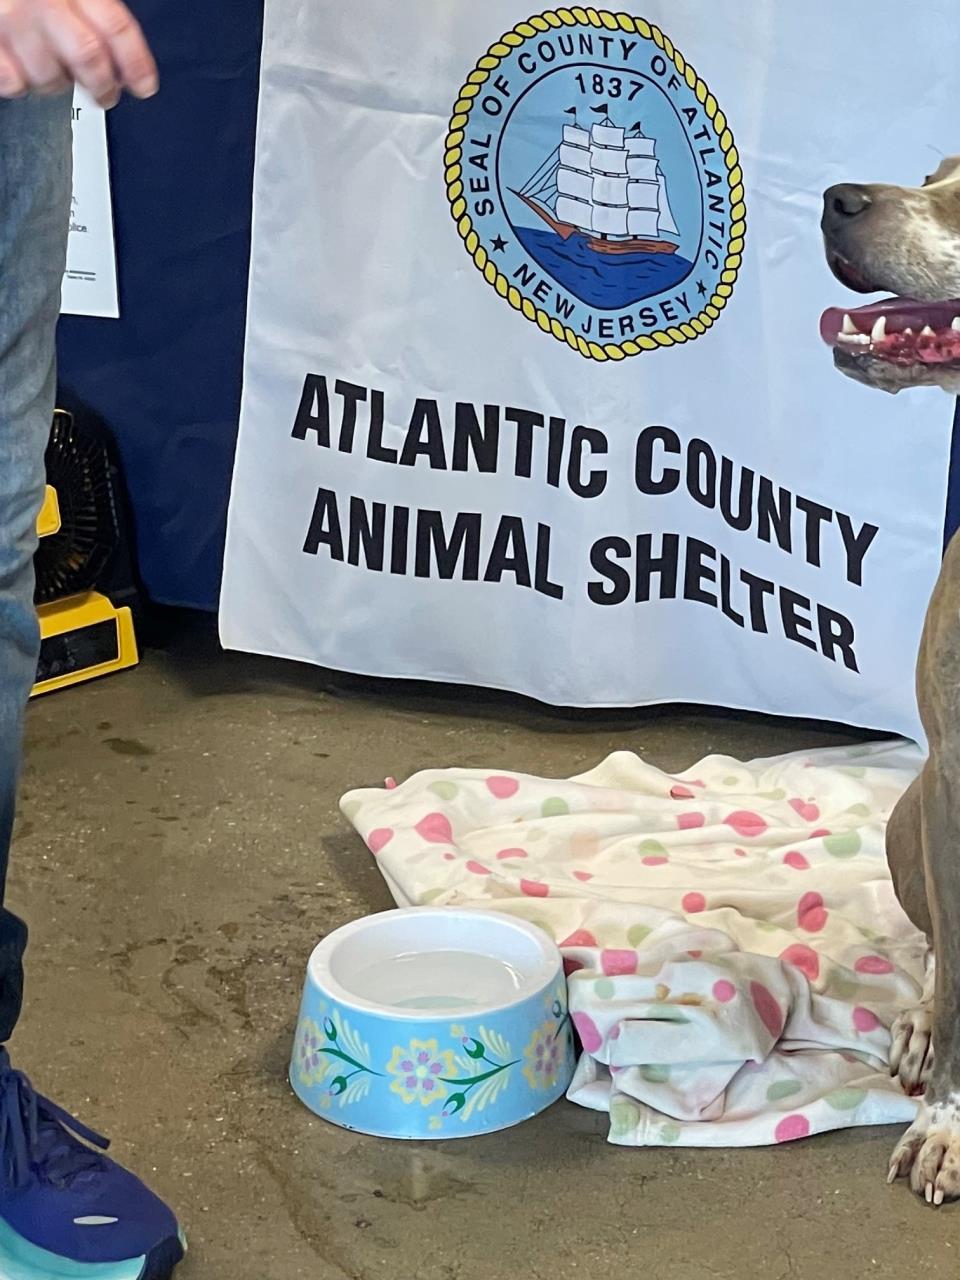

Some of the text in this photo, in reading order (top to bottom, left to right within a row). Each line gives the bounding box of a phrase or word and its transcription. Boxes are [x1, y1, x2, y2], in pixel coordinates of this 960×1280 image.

[470, 33, 725, 270] SEAL OF COUNTY OF ATLANTIC
[574, 73, 645, 102] 1837
[513, 262, 691, 338] NEW JERSEY
[290, 372, 880, 588] ATLANTIC COUNTY
[302, 486, 860, 674] ANIMAL SHELTER
